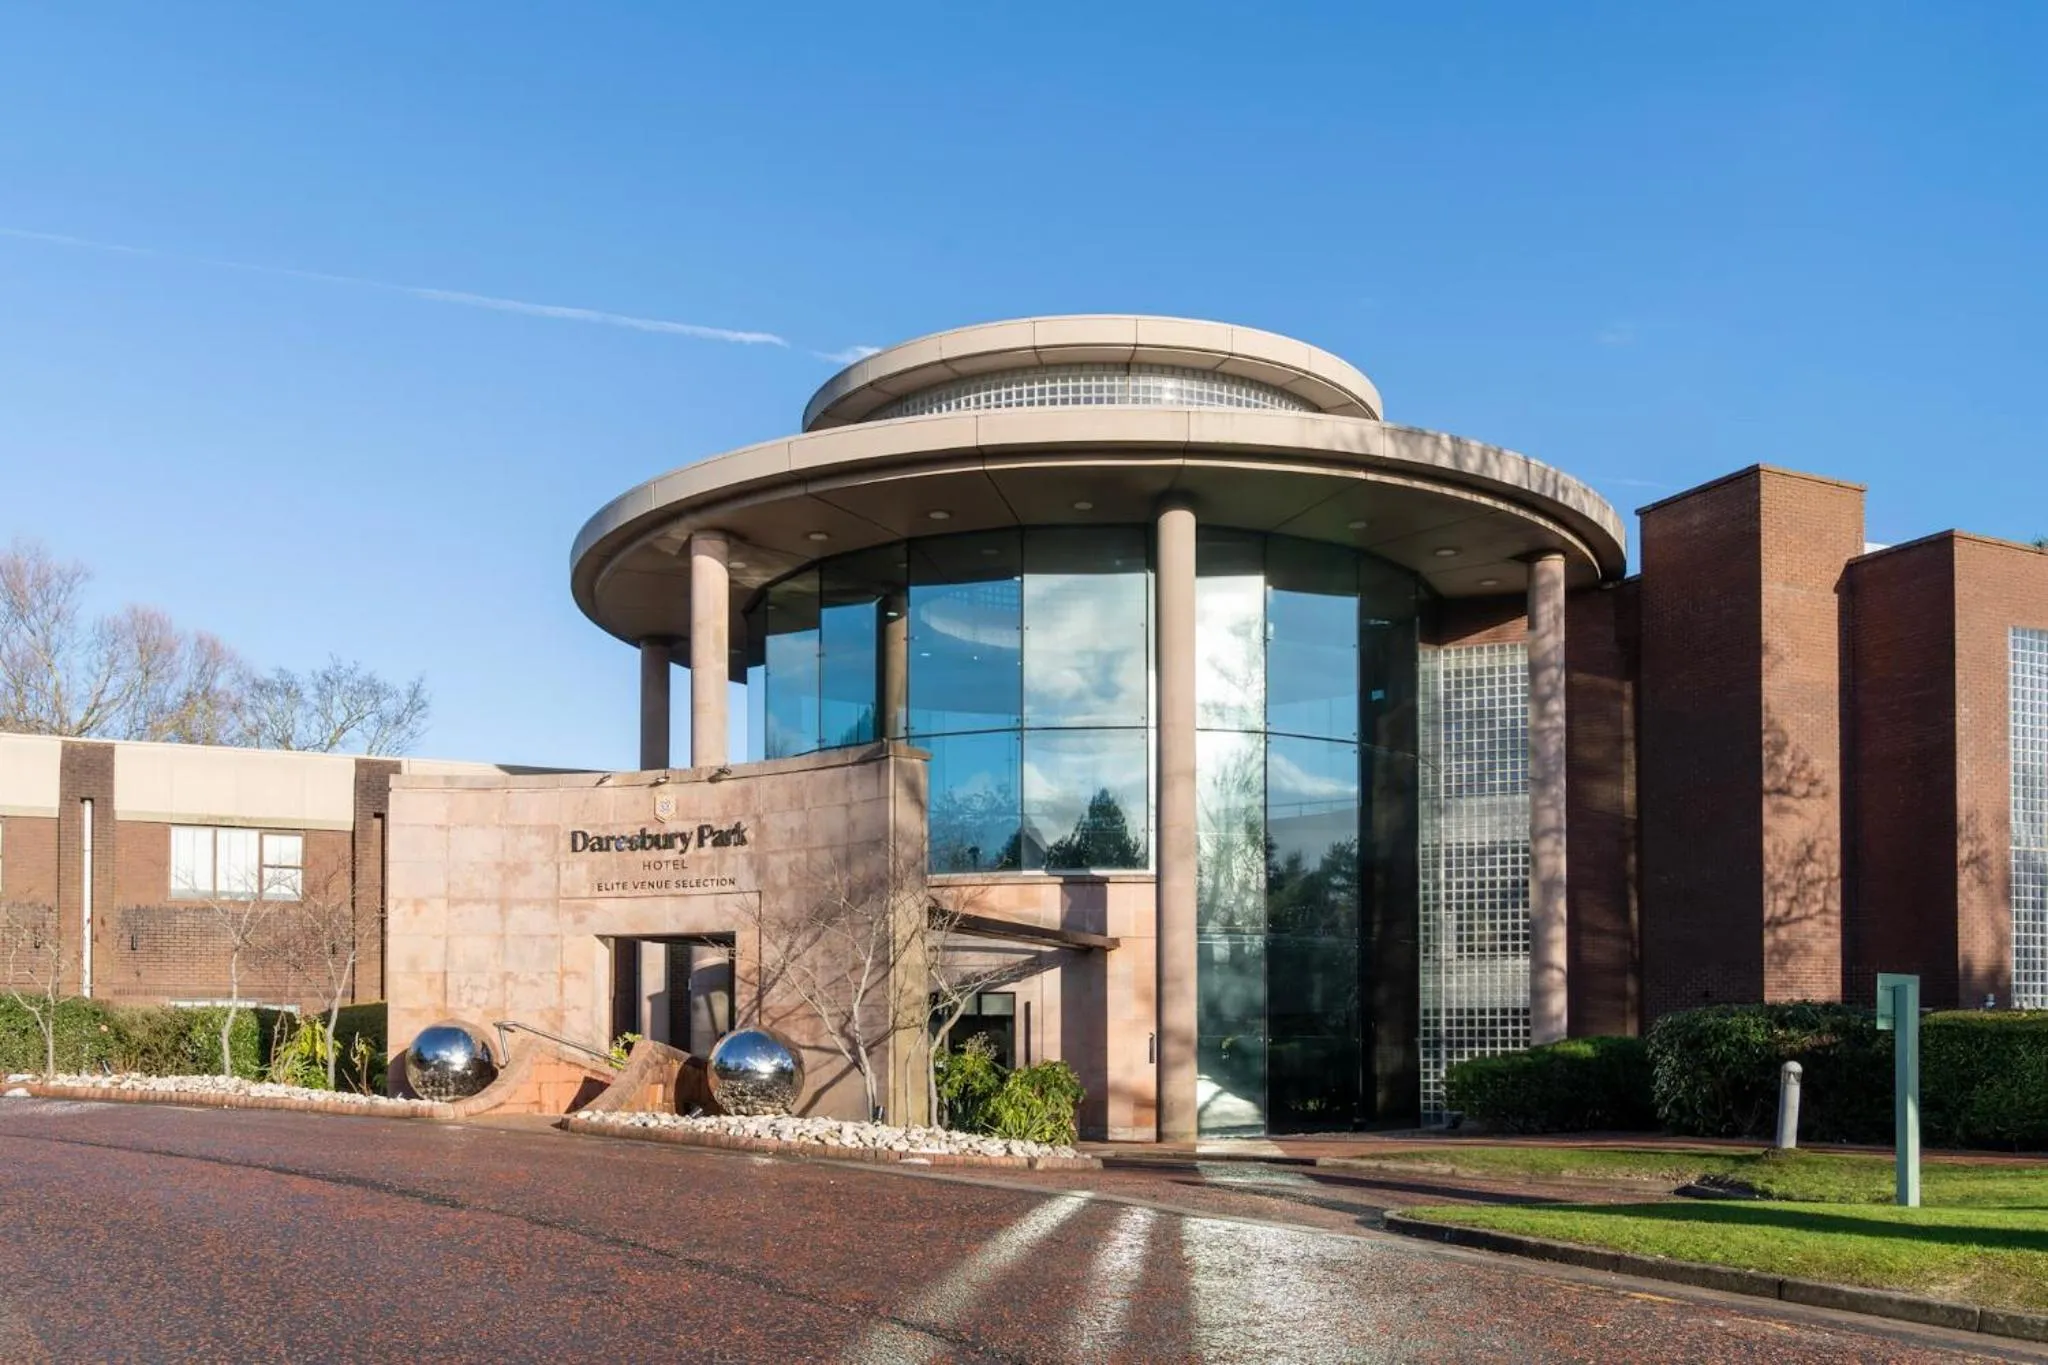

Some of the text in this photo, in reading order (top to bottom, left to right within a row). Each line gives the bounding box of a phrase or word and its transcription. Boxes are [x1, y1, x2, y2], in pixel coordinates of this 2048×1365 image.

[571, 821, 748, 855] Daresbury Park
[642, 859, 688, 871] HOTEL
[597, 877, 736, 892] ELITE VENUE SELECTION
